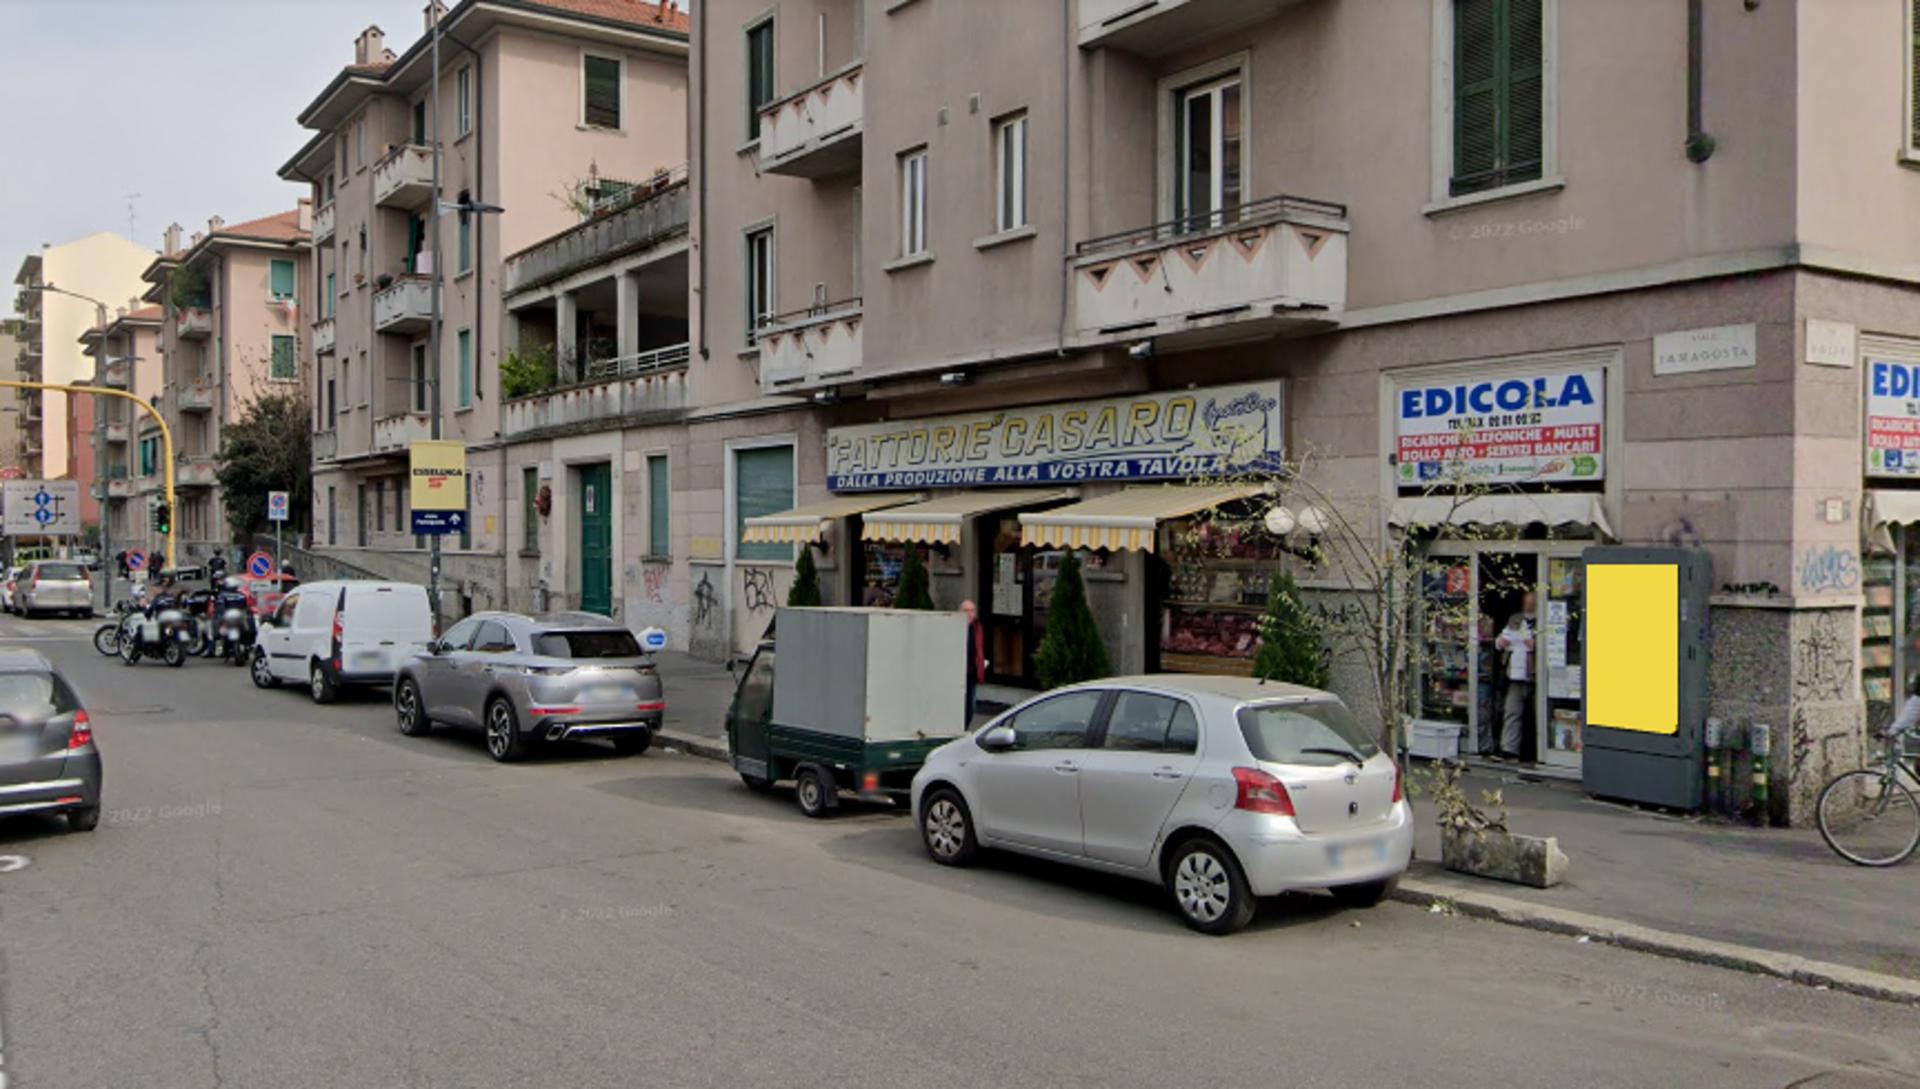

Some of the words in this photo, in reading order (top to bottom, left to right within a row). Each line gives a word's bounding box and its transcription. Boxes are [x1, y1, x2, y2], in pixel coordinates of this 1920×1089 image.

[1402, 375, 1594, 418] EDICOLA
[1000, 395, 1197, 458] CASARO
[1462, 429, 1543, 445] ELEFONICHE
[1554, 426, 1597, 439] MULTE
[1402, 449, 1441, 462] BOLLO
[1535, 440, 1595, 454] BANCARI
[836, 475, 879, 489] DALLA
[884, 468, 987, 487] PRODUZIONE
[993, 463, 1039, 482] ALLA
[1048, 460, 1130, 479] VOSTRA
[1138, 454, 1226, 476] TAVOLA
